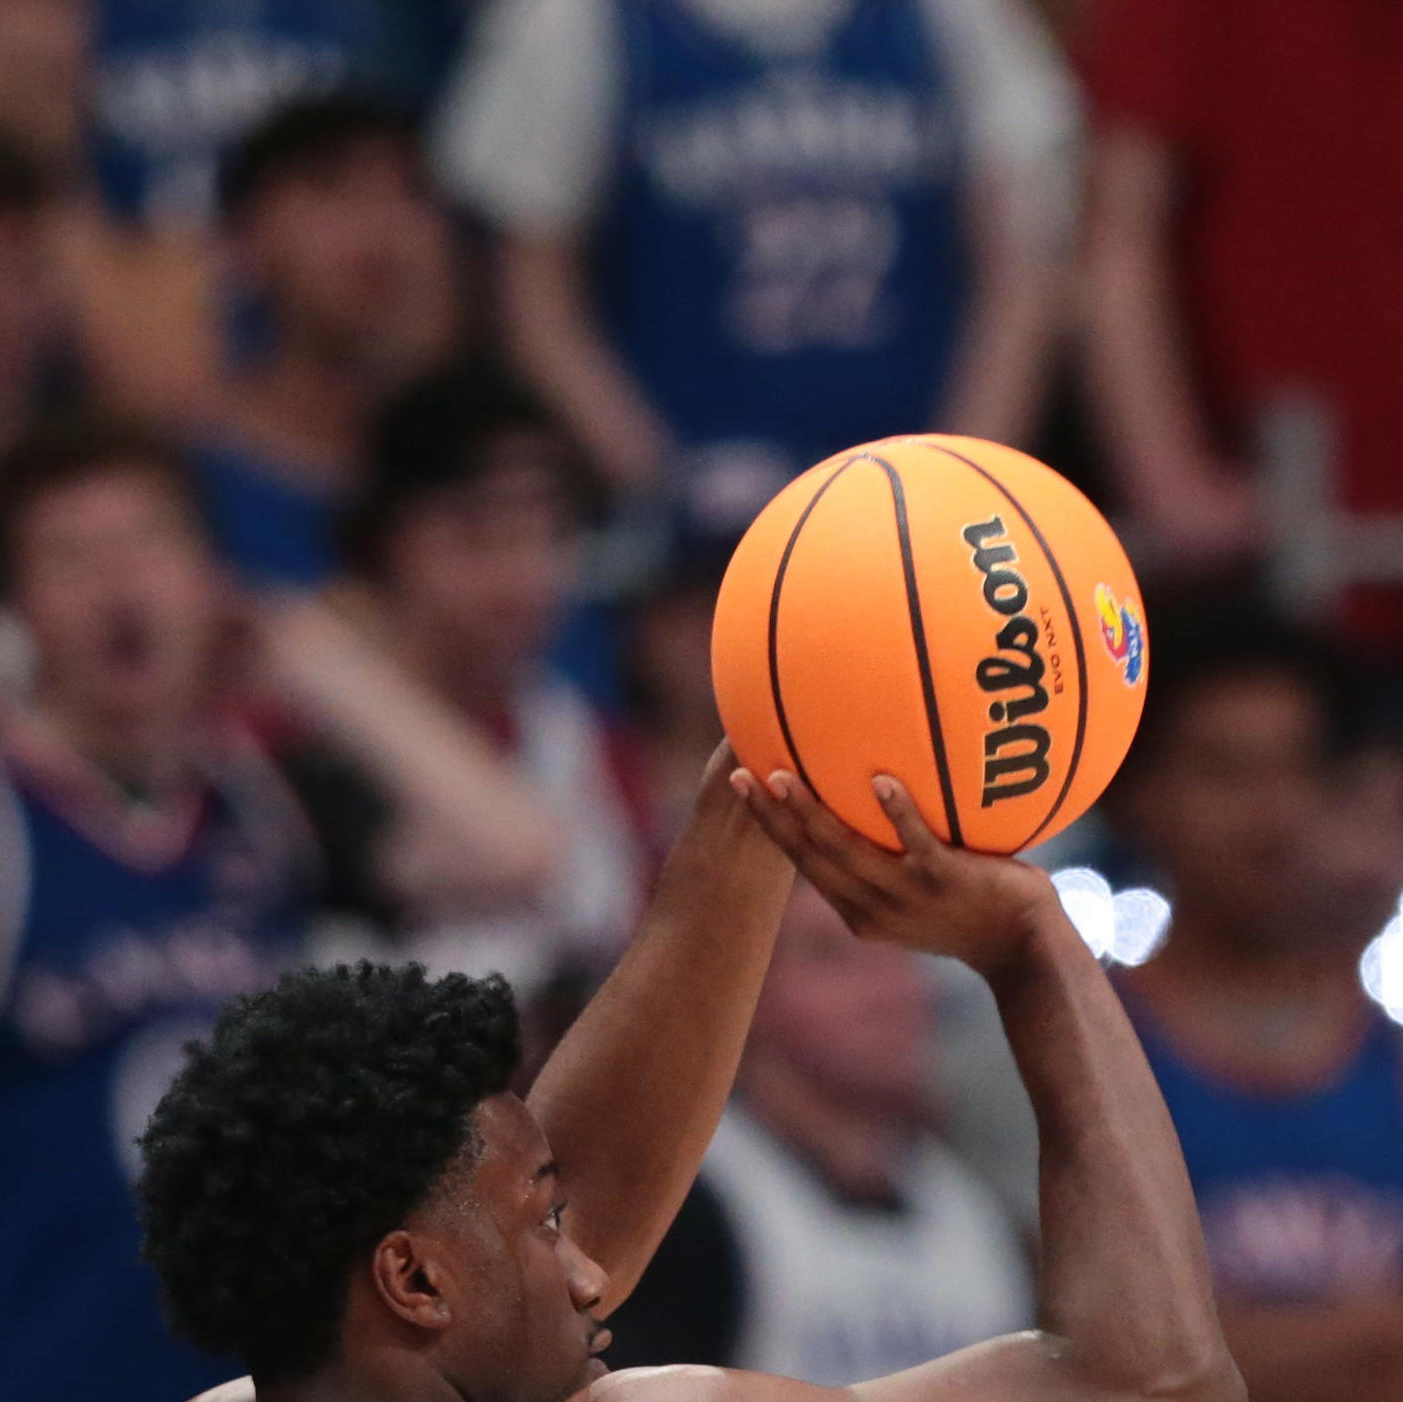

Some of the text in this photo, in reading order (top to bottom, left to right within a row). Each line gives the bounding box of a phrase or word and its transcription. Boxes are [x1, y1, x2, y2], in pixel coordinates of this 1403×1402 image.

[961, 513, 1050, 809] Wilson
[1040, 607, 1064, 695] EVO NXT
